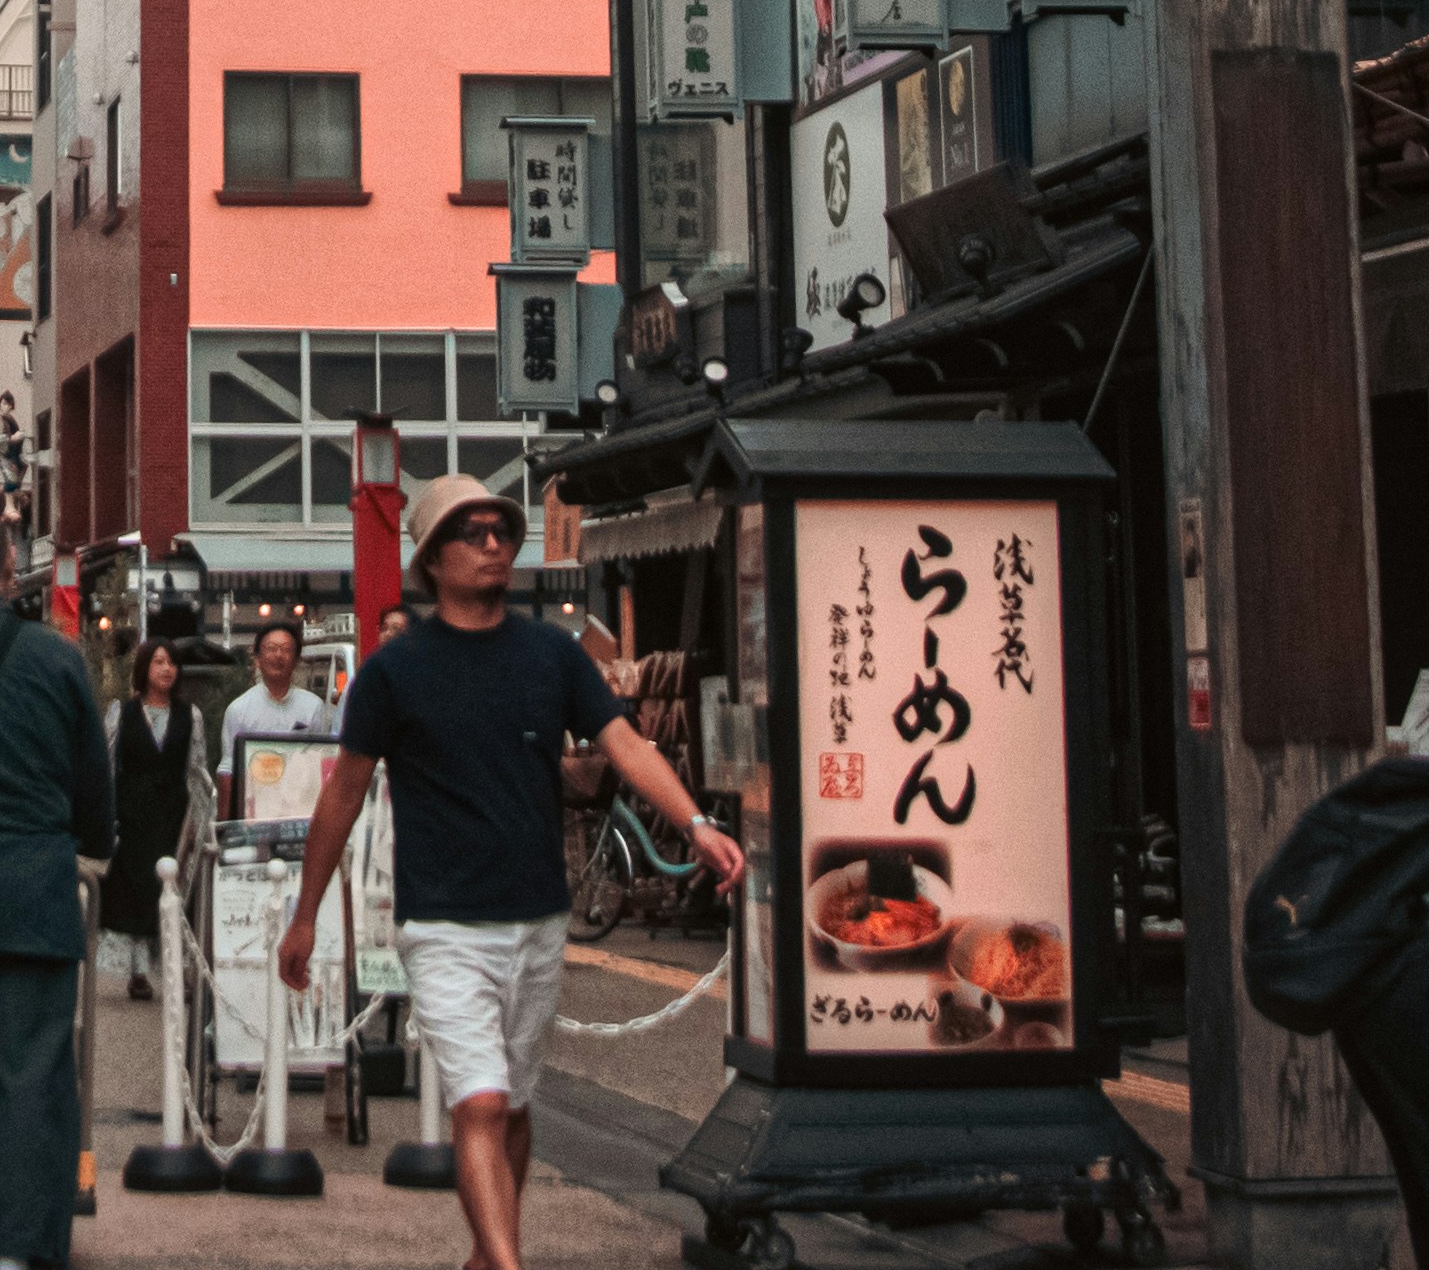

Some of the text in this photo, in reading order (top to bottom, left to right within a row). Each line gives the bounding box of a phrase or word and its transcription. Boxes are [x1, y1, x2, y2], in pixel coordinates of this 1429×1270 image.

[667, 77, 729, 96] ヴェニス
[527, 158, 552, 239] 駐車場
[555, 140, 579, 231] 時間貸し
[991, 531, 1035, 695] 浅草名代
[892, 524, 978, 827] らーめん
[809, 993, 940, 1025] ざるらーめん
